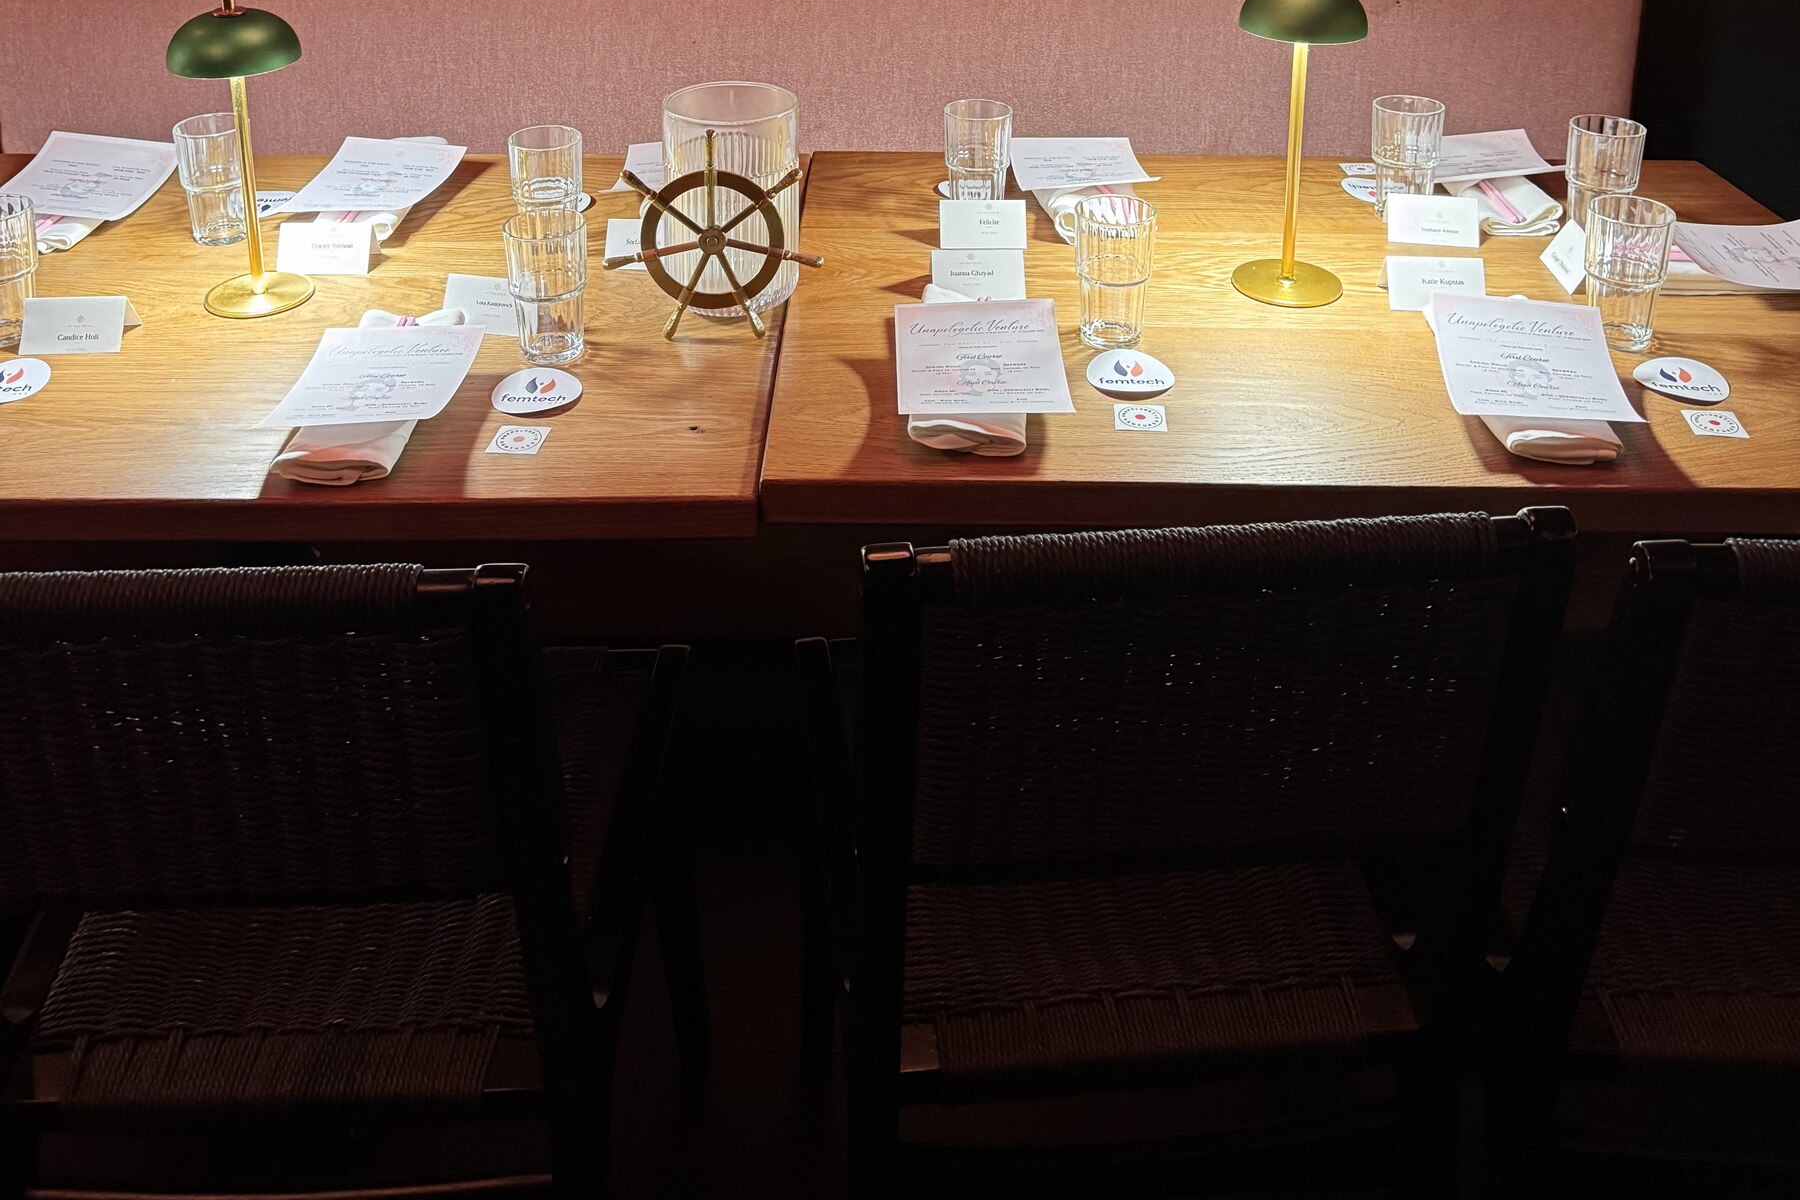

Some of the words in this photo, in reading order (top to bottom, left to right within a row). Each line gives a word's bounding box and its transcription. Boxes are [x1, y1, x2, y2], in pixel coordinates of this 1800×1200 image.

[910, 319, 984, 337] Unapologetic
[986, 318, 1029, 332] Venture
[1528, 320, 1575, 337] Venture
[57, 333, 83, 341] Candice
[1099, 377, 1165, 385] femtech
[1651, 381, 1721, 393] femtech
[501, 393, 566, 403] femtech
